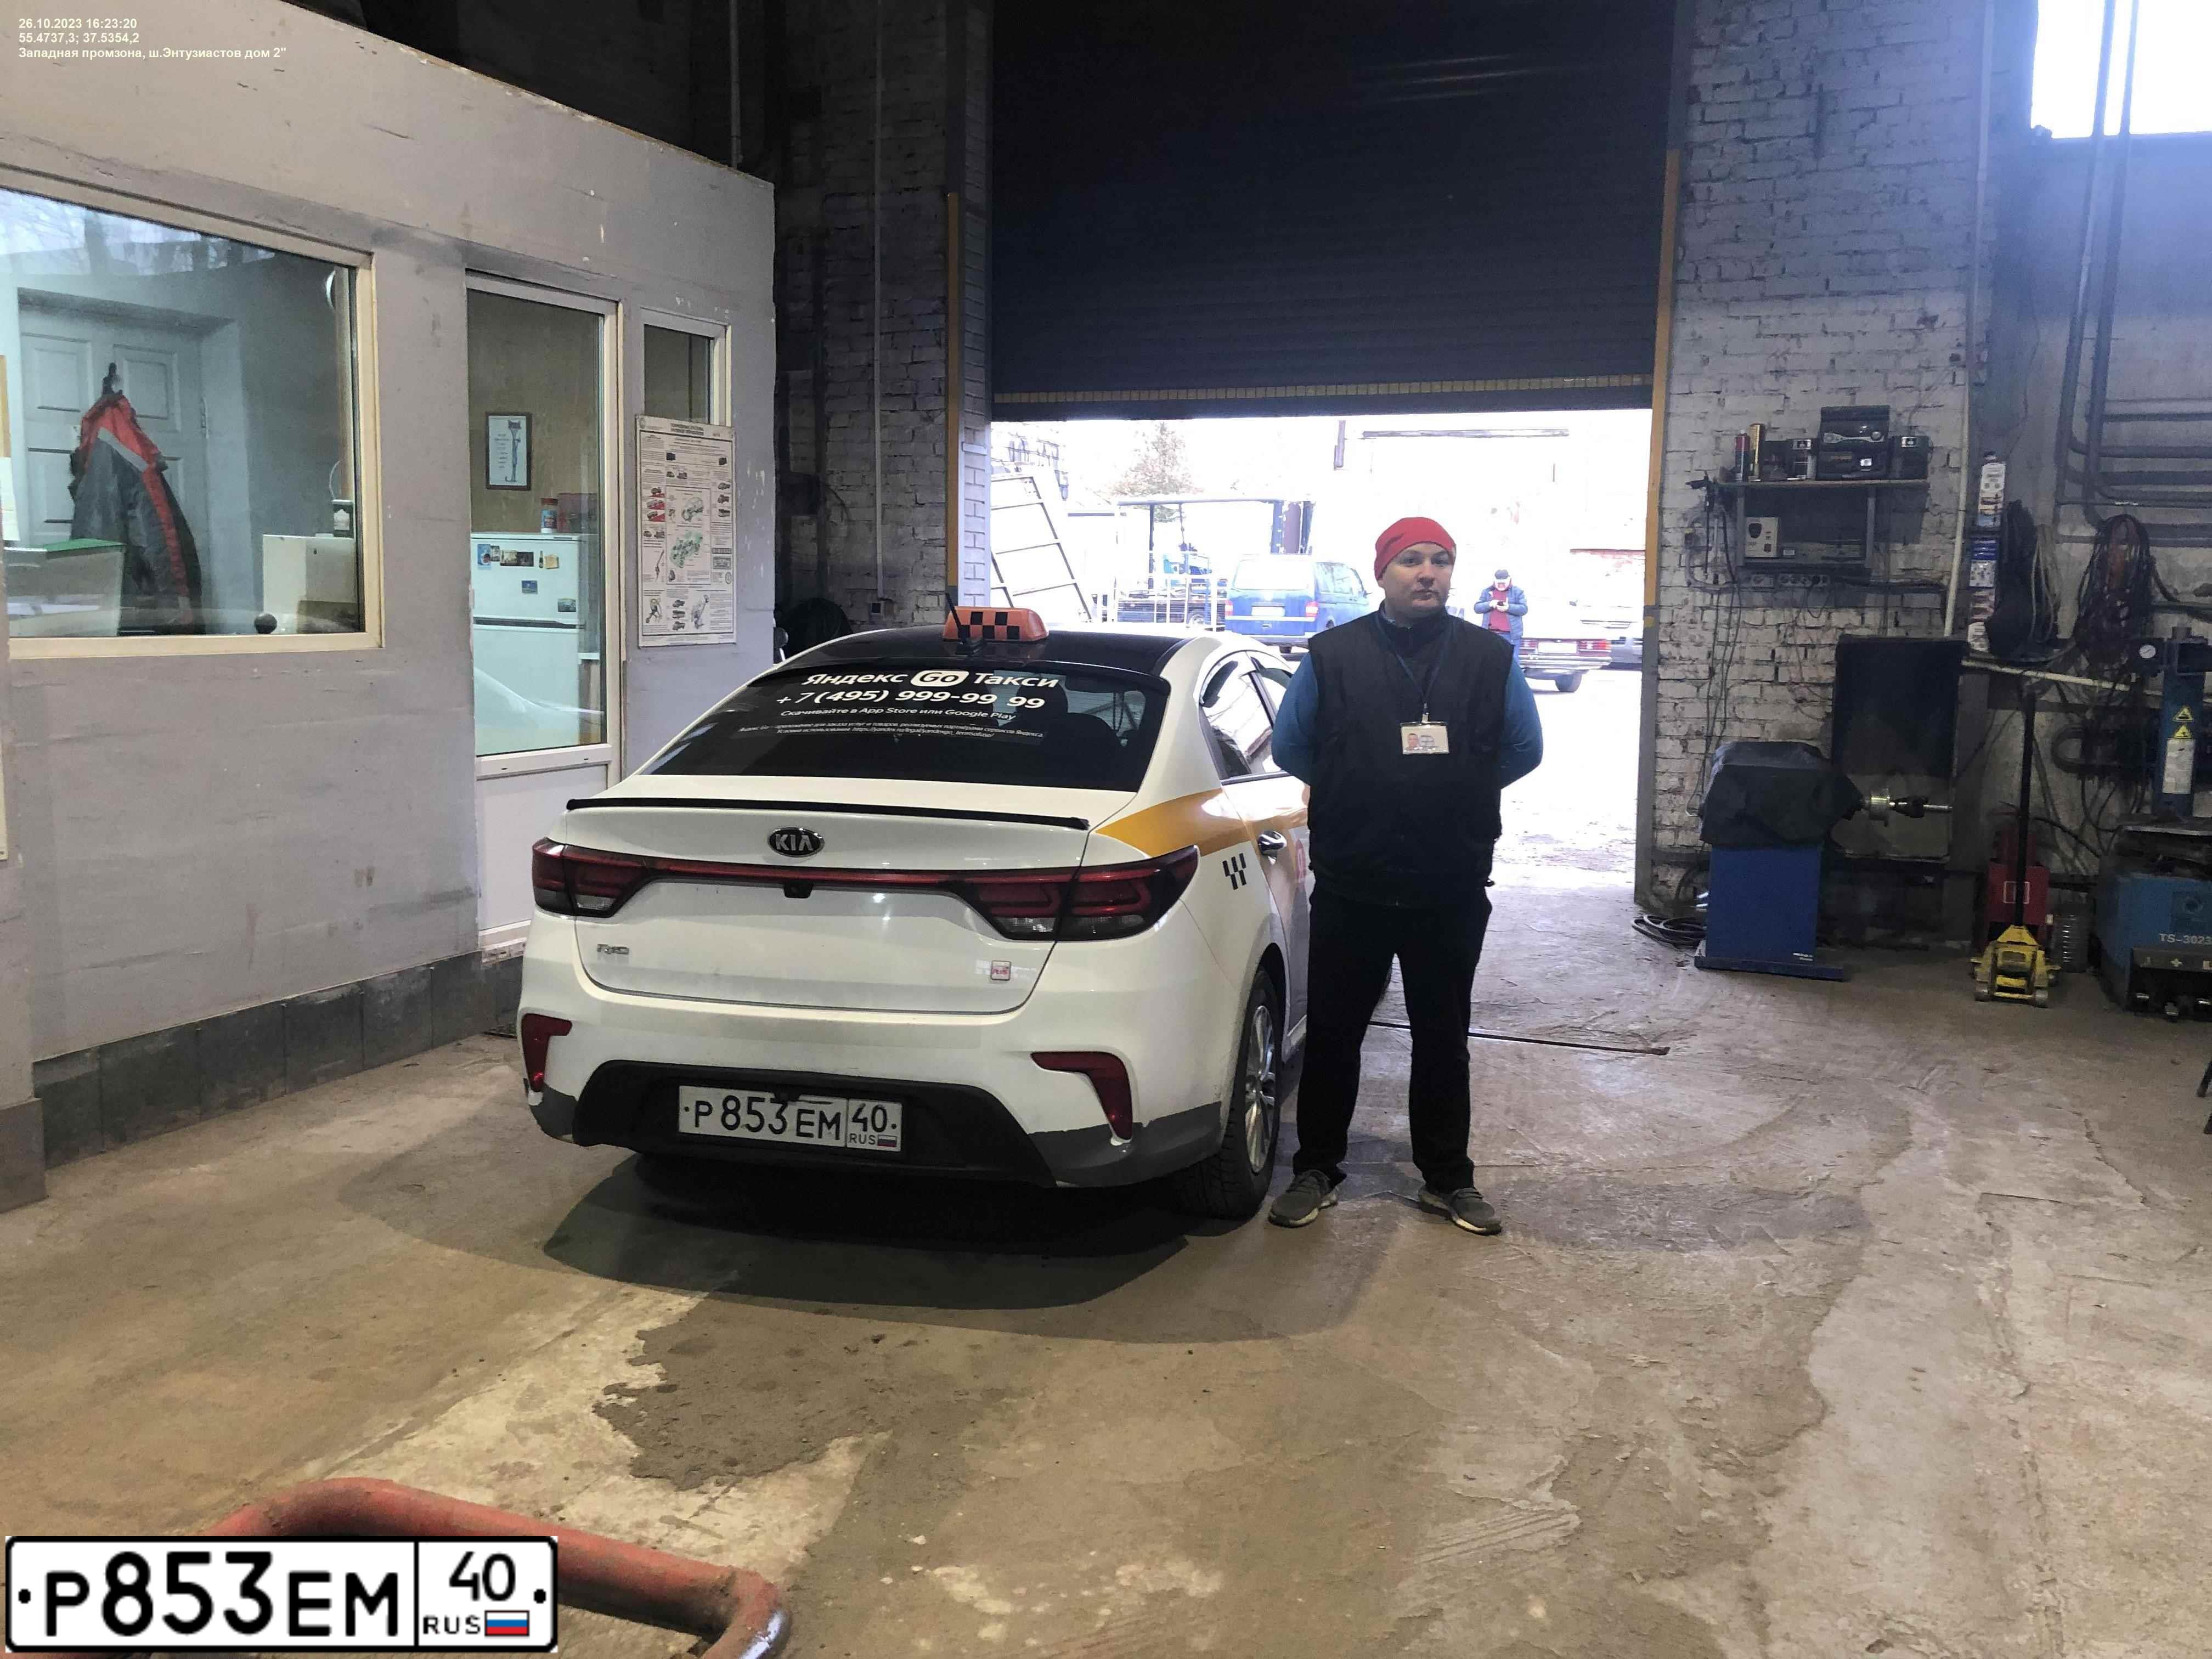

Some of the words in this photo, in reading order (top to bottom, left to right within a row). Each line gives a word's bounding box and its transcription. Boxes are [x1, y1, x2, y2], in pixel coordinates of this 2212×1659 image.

[801, 674, 909, 685] Яндекс
[919, 673, 960, 683] Go
[973, 673, 1059, 687] Такси
[781, 708, 849, 716] Скачивайте
[945, 709, 988, 718] Google
[990, 712, 1016, 720] Play
[775, 834, 814, 851] KIA
[851, 1103, 888, 1132] 40
[849, 1133, 876, 1145] RUS
